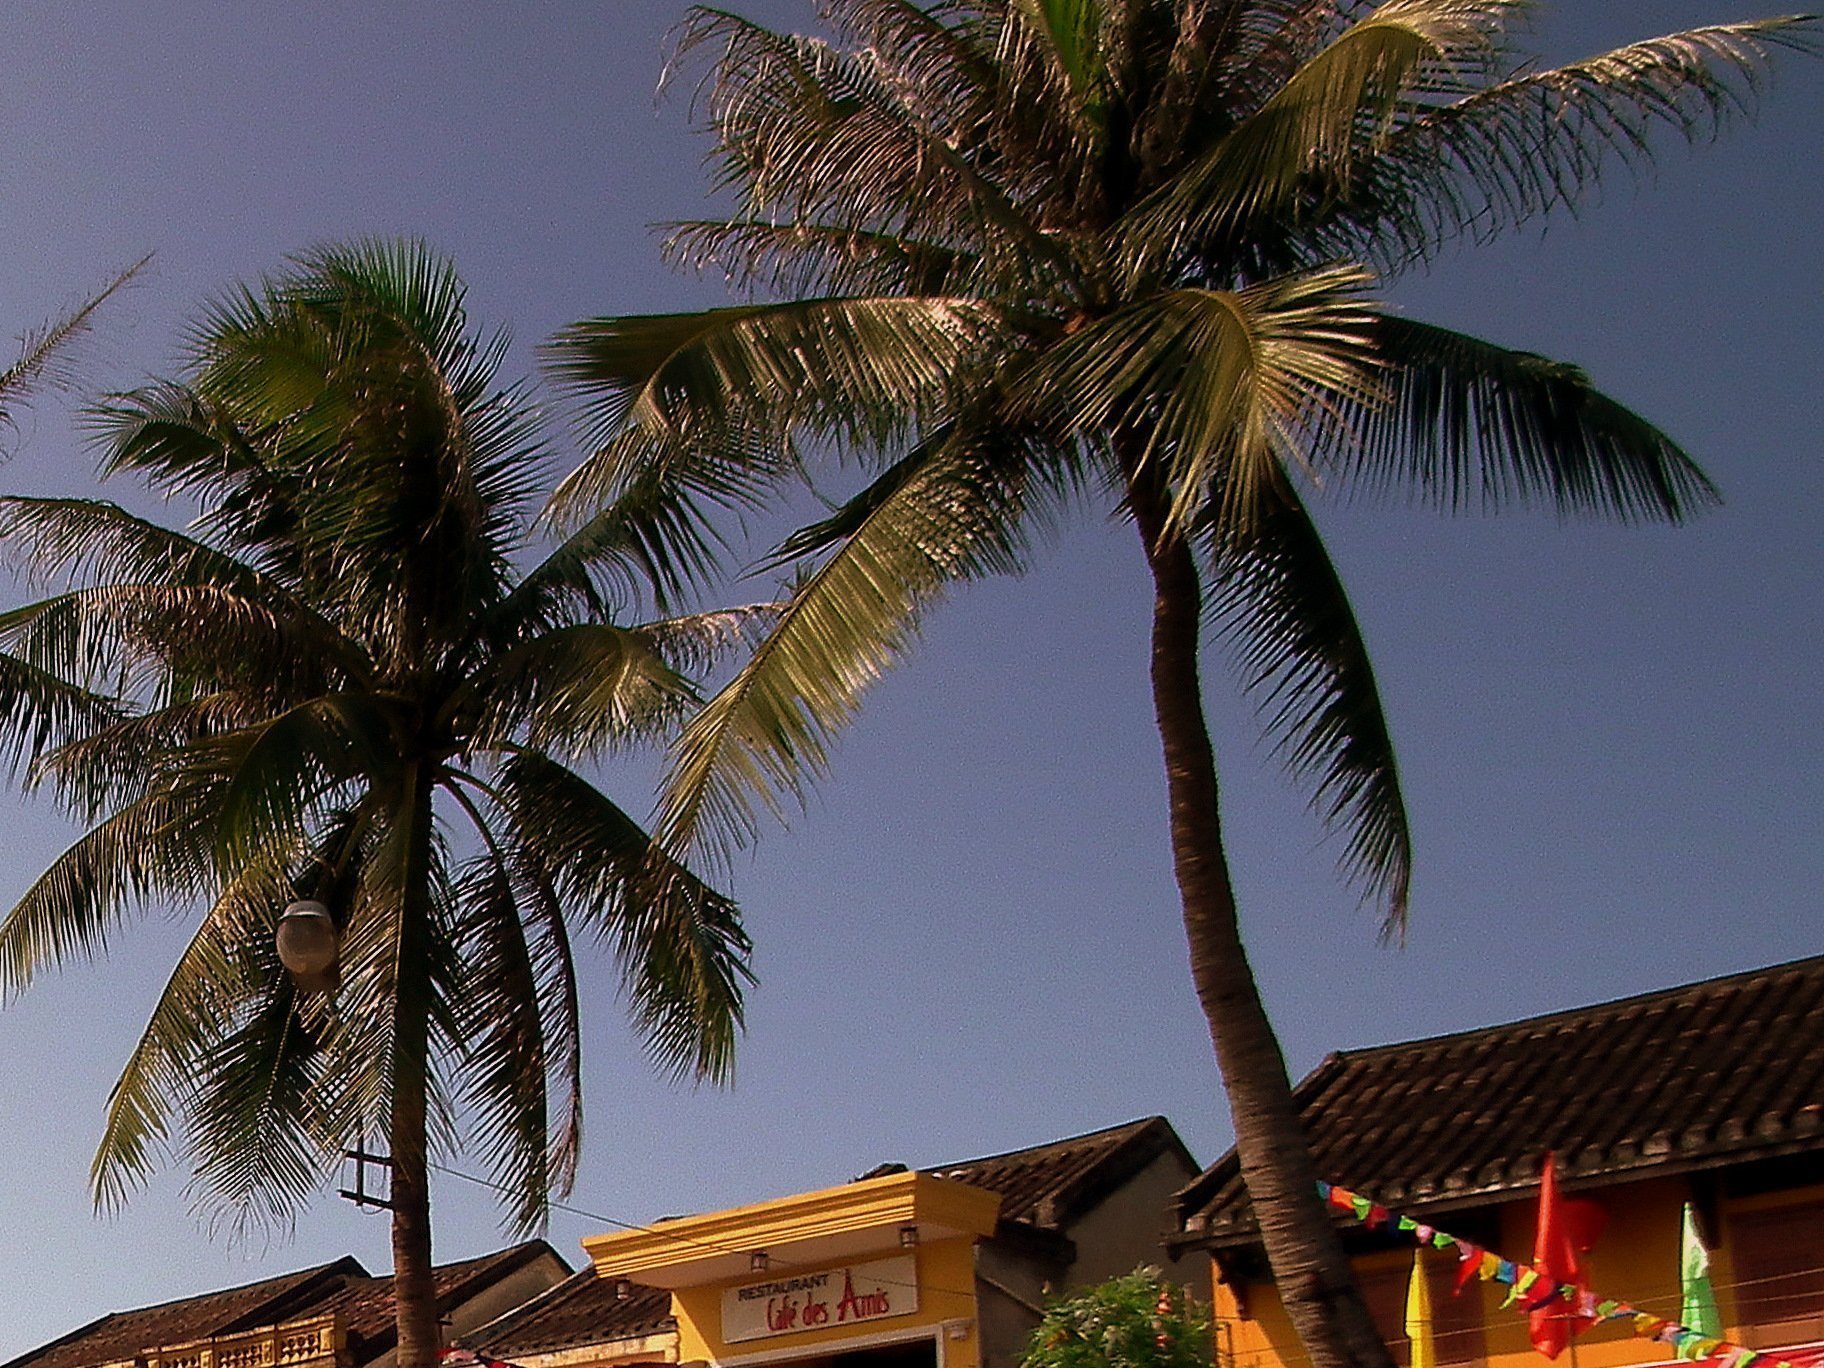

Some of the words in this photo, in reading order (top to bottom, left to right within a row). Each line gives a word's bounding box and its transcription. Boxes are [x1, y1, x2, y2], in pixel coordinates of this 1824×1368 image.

[738, 1274, 829, 1301] RESTAURANT
[766, 1294, 797, 1331] Café
[802, 1291, 828, 1326] des
[837, 1268, 890, 1322] Amis
